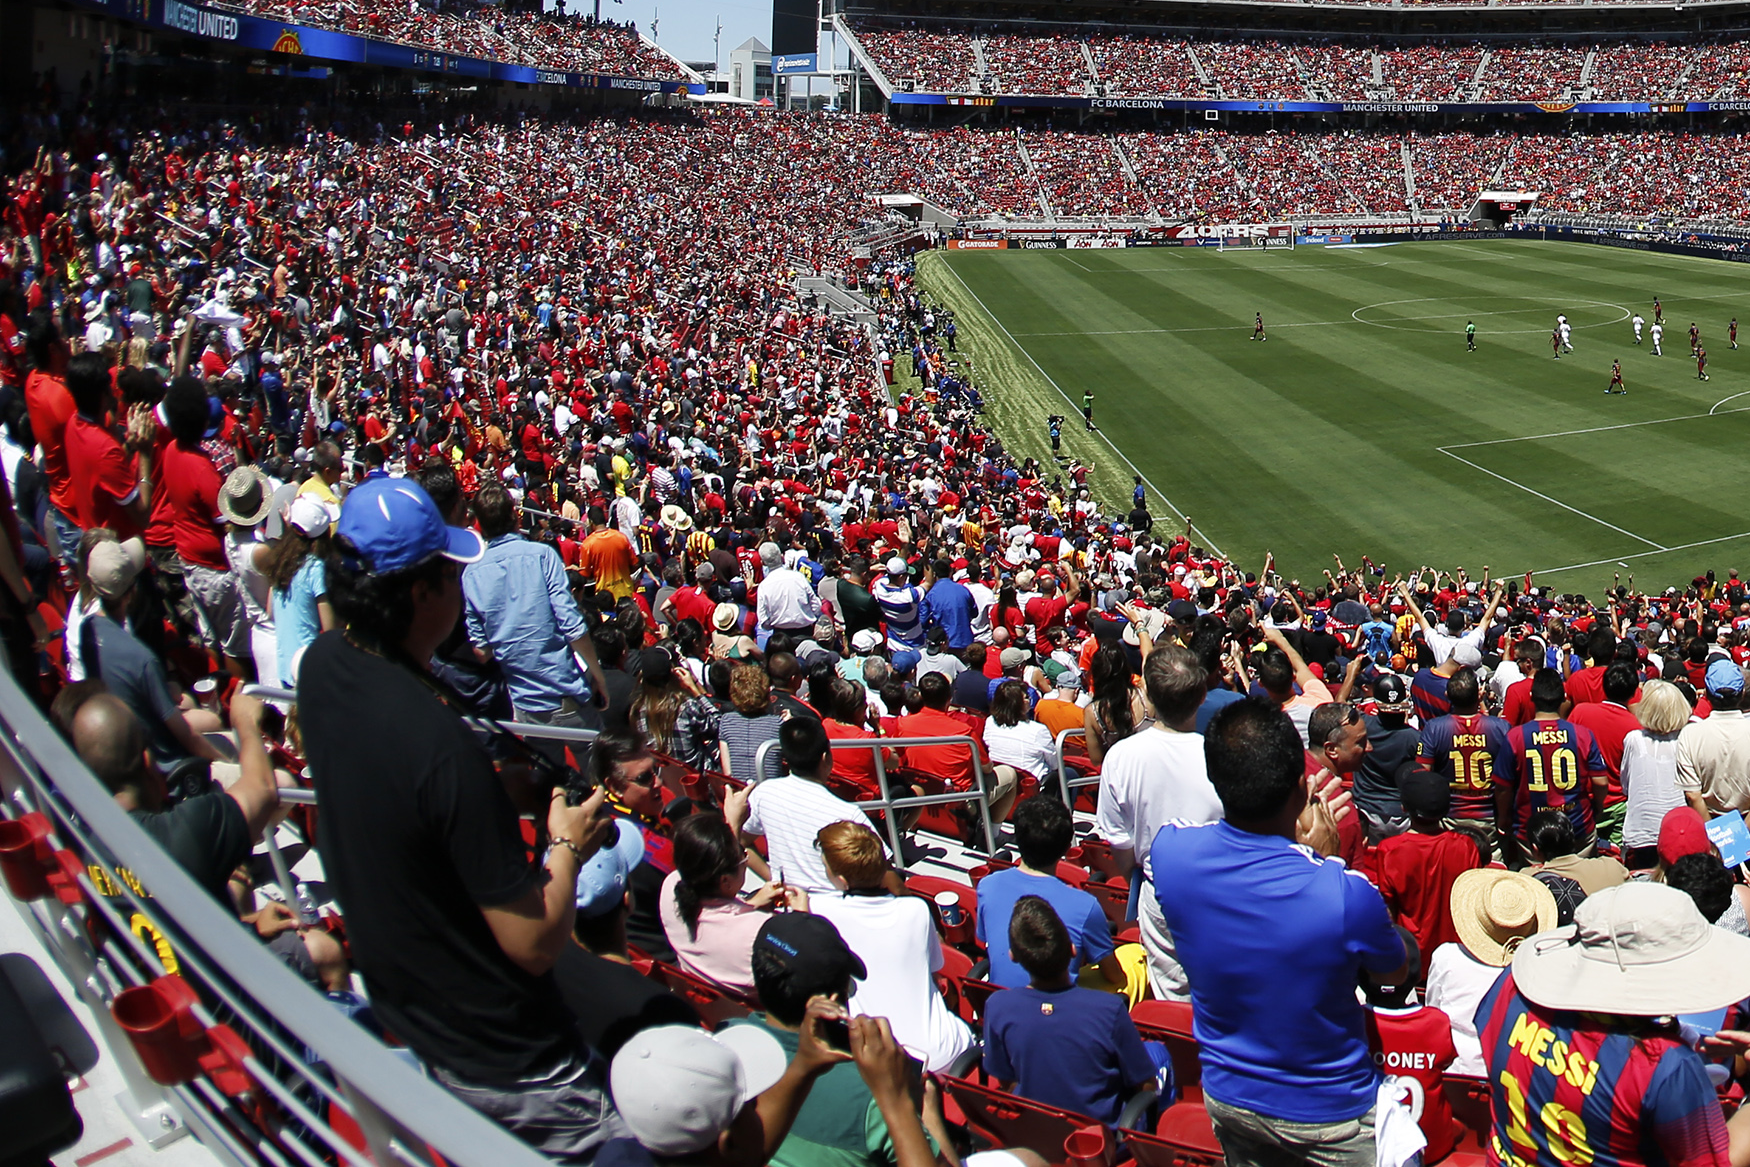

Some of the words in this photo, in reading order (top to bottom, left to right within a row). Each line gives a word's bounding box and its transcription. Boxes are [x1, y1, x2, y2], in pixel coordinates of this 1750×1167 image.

[198, 10, 238, 40] UNITED
[610, 78, 643, 91] MANCHESTER
[644, 81, 661, 91] UNITED
[1091, 99, 1104, 108] FC
[1106, 99, 1164, 109] BARCELONA
[1343, 104, 1402, 112] MANCHESTER
[1257, 237, 1287, 246] GINNESS
[1424, 232, 1505, 240] AFRESERVE.com
[1026, 241, 1057, 249] GUINNESS
[1600, 240, 1650, 249] AFRESERVE.com
[1453, 734, 1486, 748] MESSI
[1532, 730, 1568, 745] MESSI
[1450, 750, 1492, 790] 10
[1526, 748, 1576, 791] 10
[1374, 1052, 1435, 1069] OONEY
[1508, 1012, 1599, 1095] MESSI
[1500, 1069, 1596, 1165] 10
